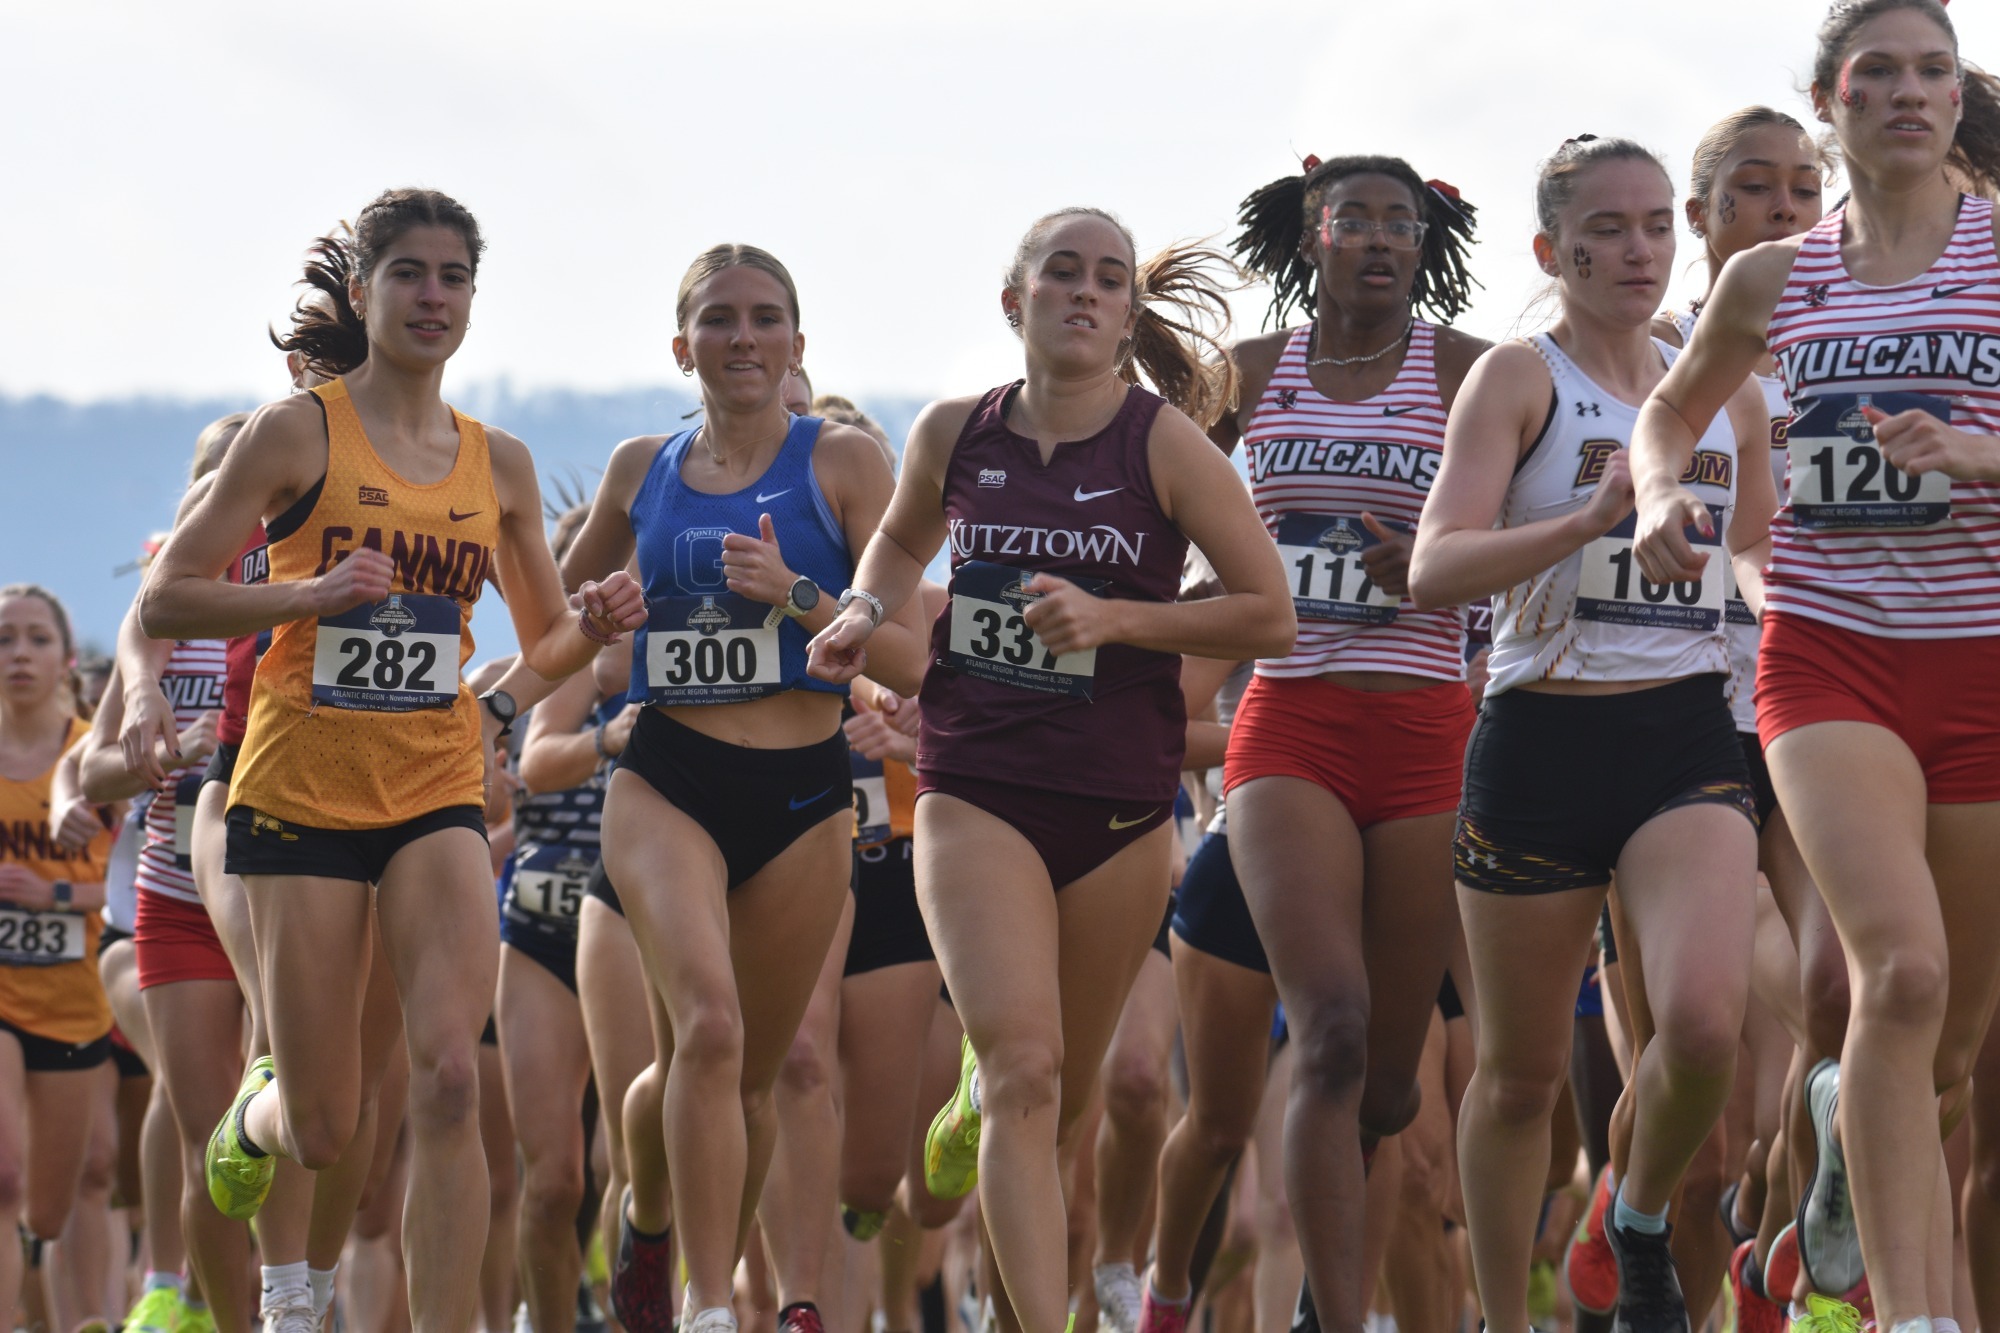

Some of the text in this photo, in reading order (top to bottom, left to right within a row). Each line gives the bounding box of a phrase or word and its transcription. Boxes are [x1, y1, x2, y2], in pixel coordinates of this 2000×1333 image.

[1777, 331, 2000, 399] VULCANS
[980, 474, 1005, 483] PSAC
[1251, 440, 1442, 491] VULCANS
[1810, 446, 1921, 503] 120
[359, 491, 389, 502] PSAC
[686, 530, 728, 542] PIONEER
[950, 518, 1145, 566] KUTZTOWN
[1295, 554, 1375, 603] 117
[336, 636, 437, 692] 282
[665, 637, 757, 686] 300
[332, 690, 360, 699] ATLANTIC
[361, 692, 385, 701] REGION
[389, 694, 419, 703] November
[426, 696, 441, 704] 2025
[687, 688, 708, 696] REGION
[712, 687, 741, 695] November
[0, 917, 66, 955] 283
